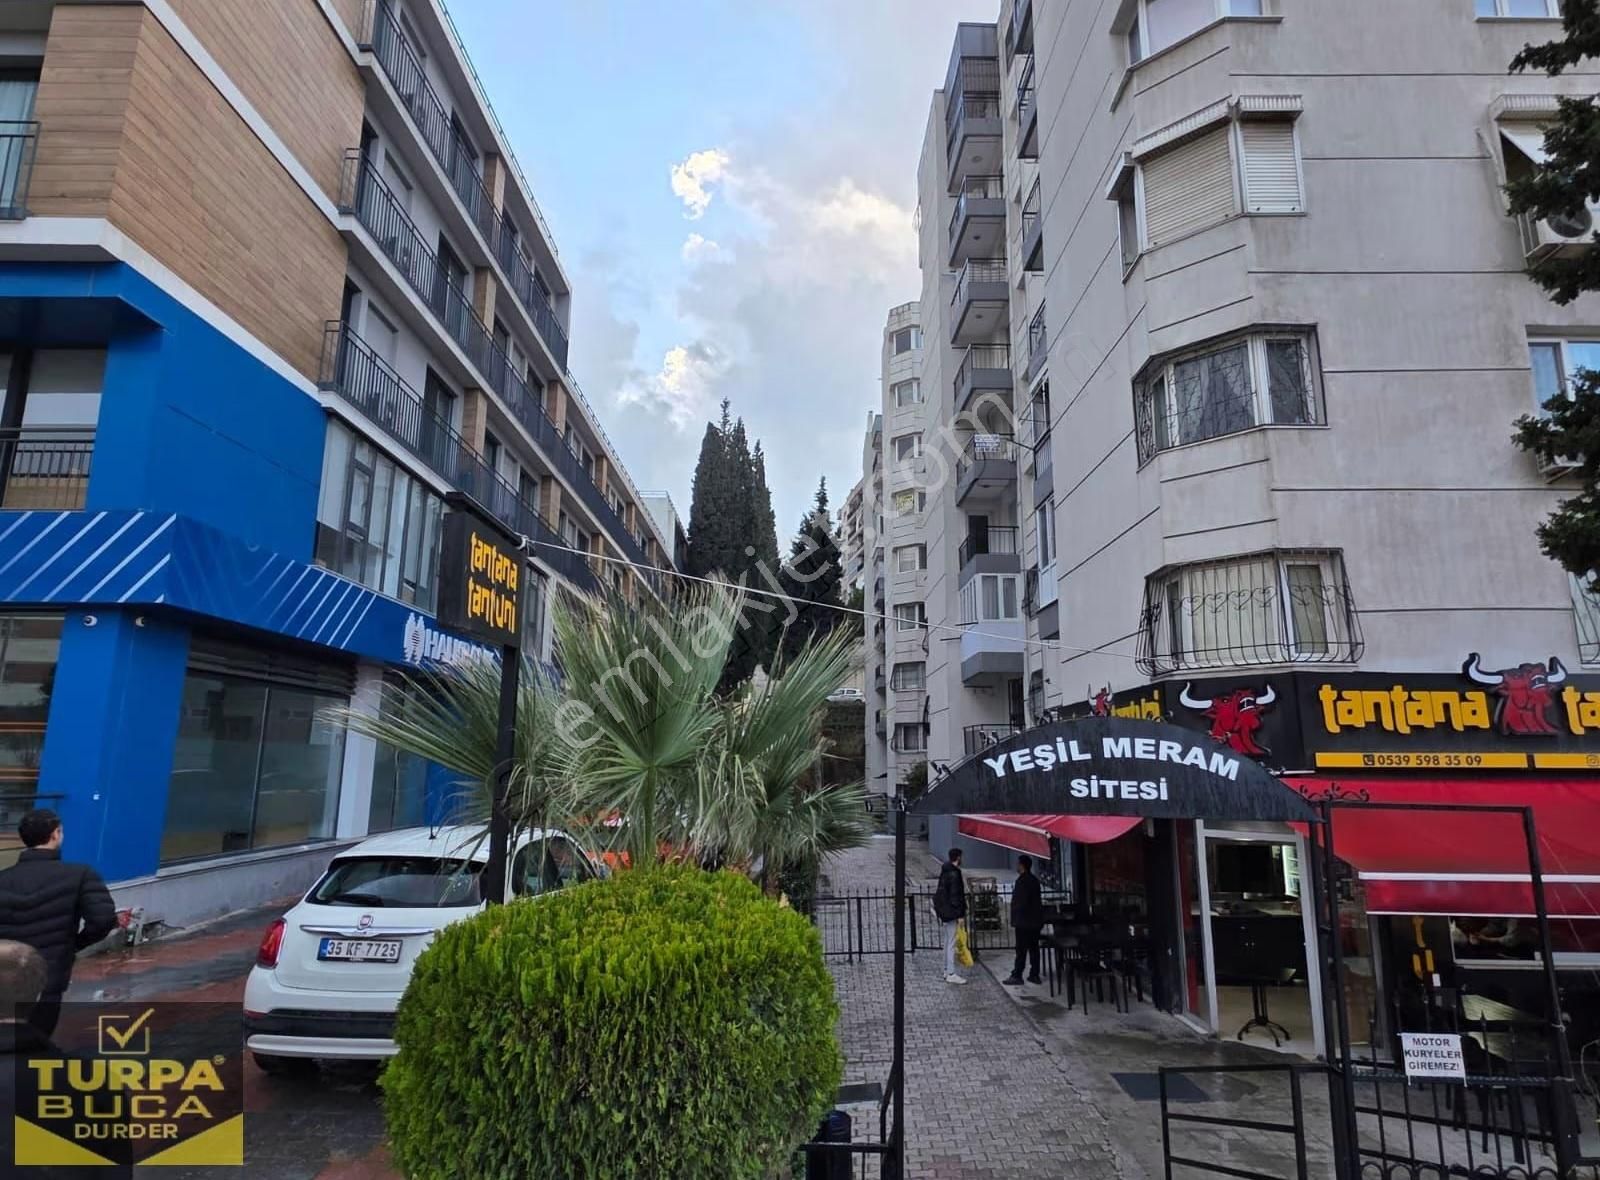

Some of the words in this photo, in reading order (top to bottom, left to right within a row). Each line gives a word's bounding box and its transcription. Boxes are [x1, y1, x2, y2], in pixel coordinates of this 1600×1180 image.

[471, 531, 518, 592] tantana
[467, 576, 516, 635] tantuni
[1318, 684, 1490, 734] tantana
[983, 737, 1092, 778] YEŞİL
[1102, 737, 1240, 781] MERAM
[1377, 755, 1410, 767] 0539
[1415, 755, 1441, 767] 598
[1445, 755, 1461, 767] 35
[1466, 755, 1482, 767] 09
[1070, 775, 1169, 801] SİTESİ
[327, 941, 343, 956] 35
[345, 942, 363, 956] KF
[366, 943, 397, 957] 7725
[1412, 1037, 1450, 1047] MOTOR
[1404, 1049, 1461, 1059] KURYELER
[1408, 1061, 1460, 1071] GİREMEZ!
